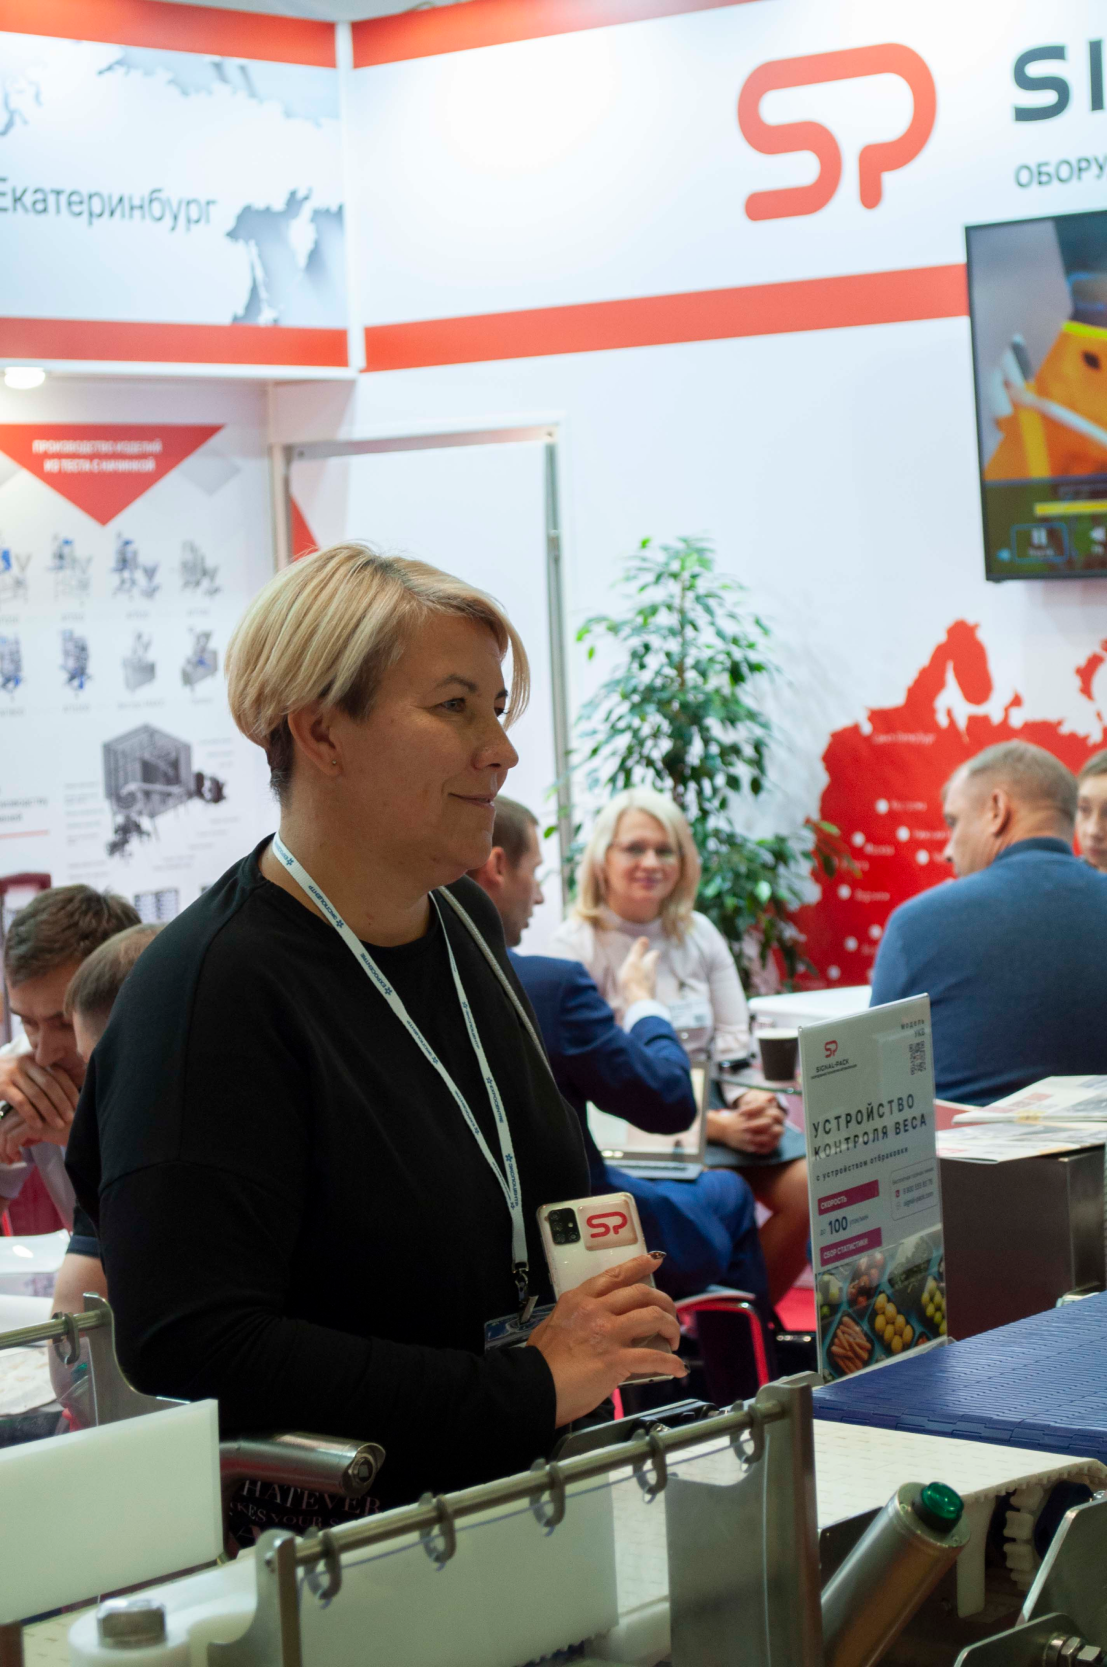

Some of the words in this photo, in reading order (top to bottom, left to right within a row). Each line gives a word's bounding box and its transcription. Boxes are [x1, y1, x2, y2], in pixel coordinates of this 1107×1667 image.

[812, 1093, 915, 1138] УСТРОЙСТВО
[814, 1125, 889, 1160] КОНТРОЛЯ
[894, 1113, 927, 1136] ВЕСА
[822, 1159, 868, 1181] устройством
[586, 1211, 628, 1239] SP
[828, 1216, 848, 1235] 100
[242, 1480, 381, 1517] HATEVER
